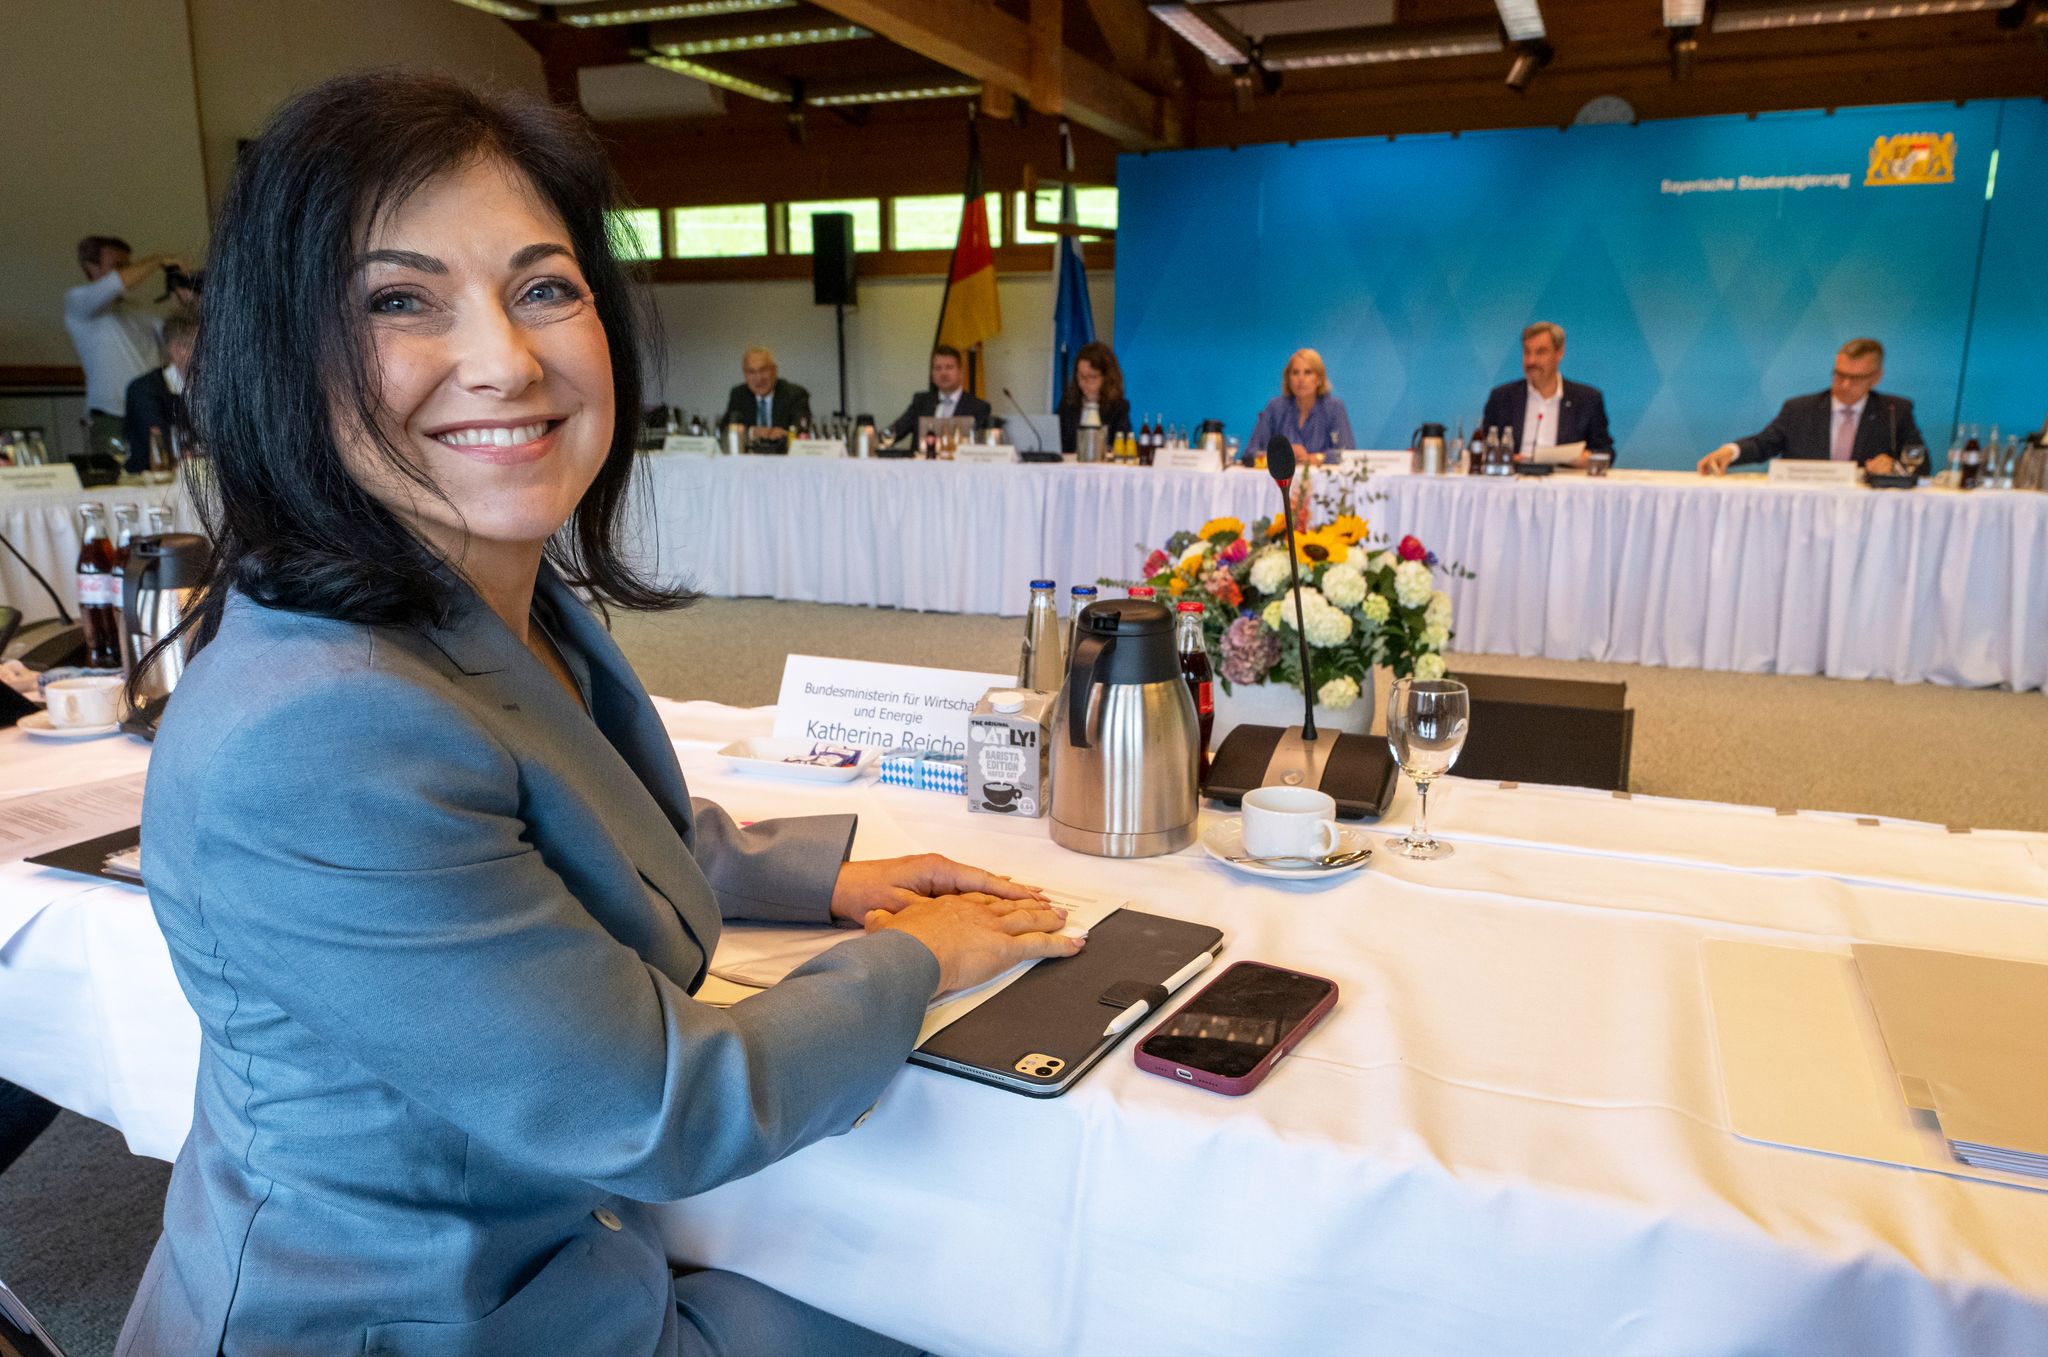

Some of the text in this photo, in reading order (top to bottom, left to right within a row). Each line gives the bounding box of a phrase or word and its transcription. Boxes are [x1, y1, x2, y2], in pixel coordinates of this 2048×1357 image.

[804, 682, 899, 703] Bundesministerin
[903, 692, 920, 706] für
[853, 706, 923, 726] und Energie
[806, 719, 966, 756] Katherina Reiche
[985, 751, 1019, 761] BARISTA
[987, 761, 1018, 771] EDITION
